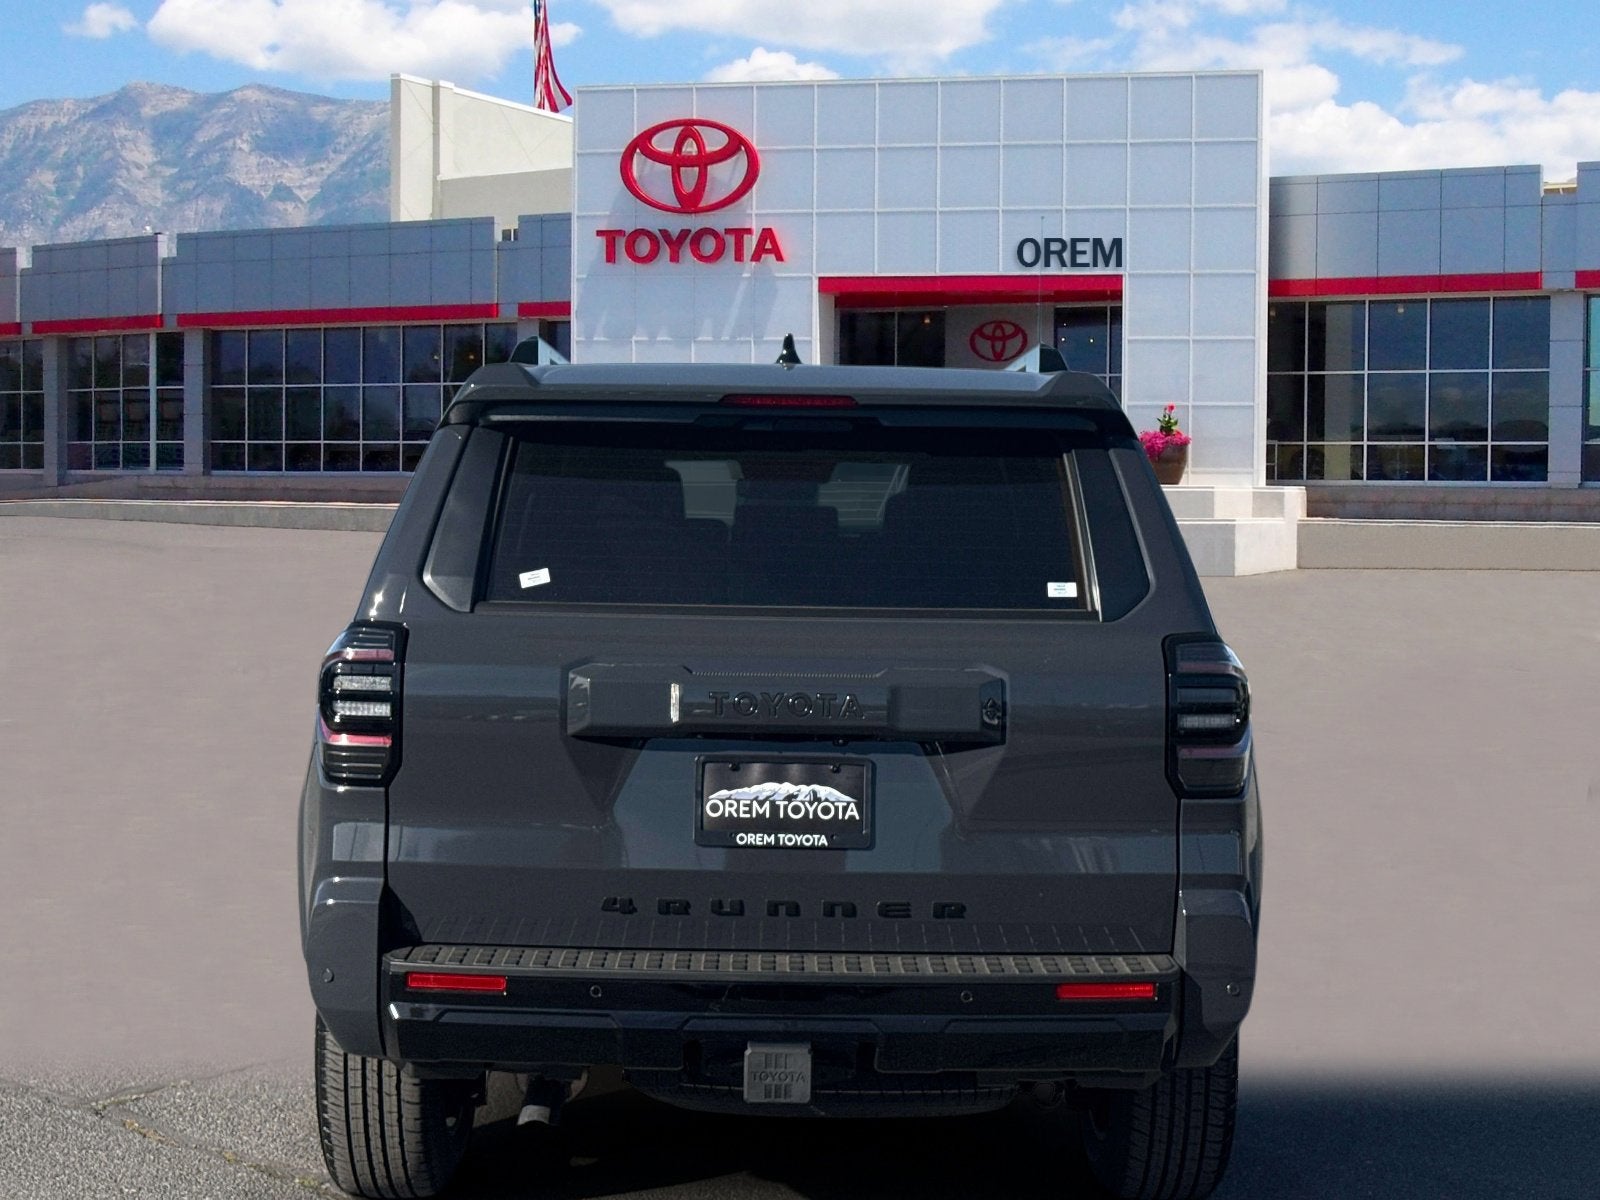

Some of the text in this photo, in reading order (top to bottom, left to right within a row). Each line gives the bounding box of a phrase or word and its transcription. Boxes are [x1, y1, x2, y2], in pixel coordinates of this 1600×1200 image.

[596, 227, 785, 264] TOYOTA
[1016, 237, 1123, 269] OREM
[708, 691, 866, 719] TOYOTA
[705, 799, 860, 821] OREM TOYOTA
[735, 832, 828, 847] OREM TOYOTA
[601, 896, 967, 920] 4RUNNER
[751, 1070, 807, 1083] TOYOTA
